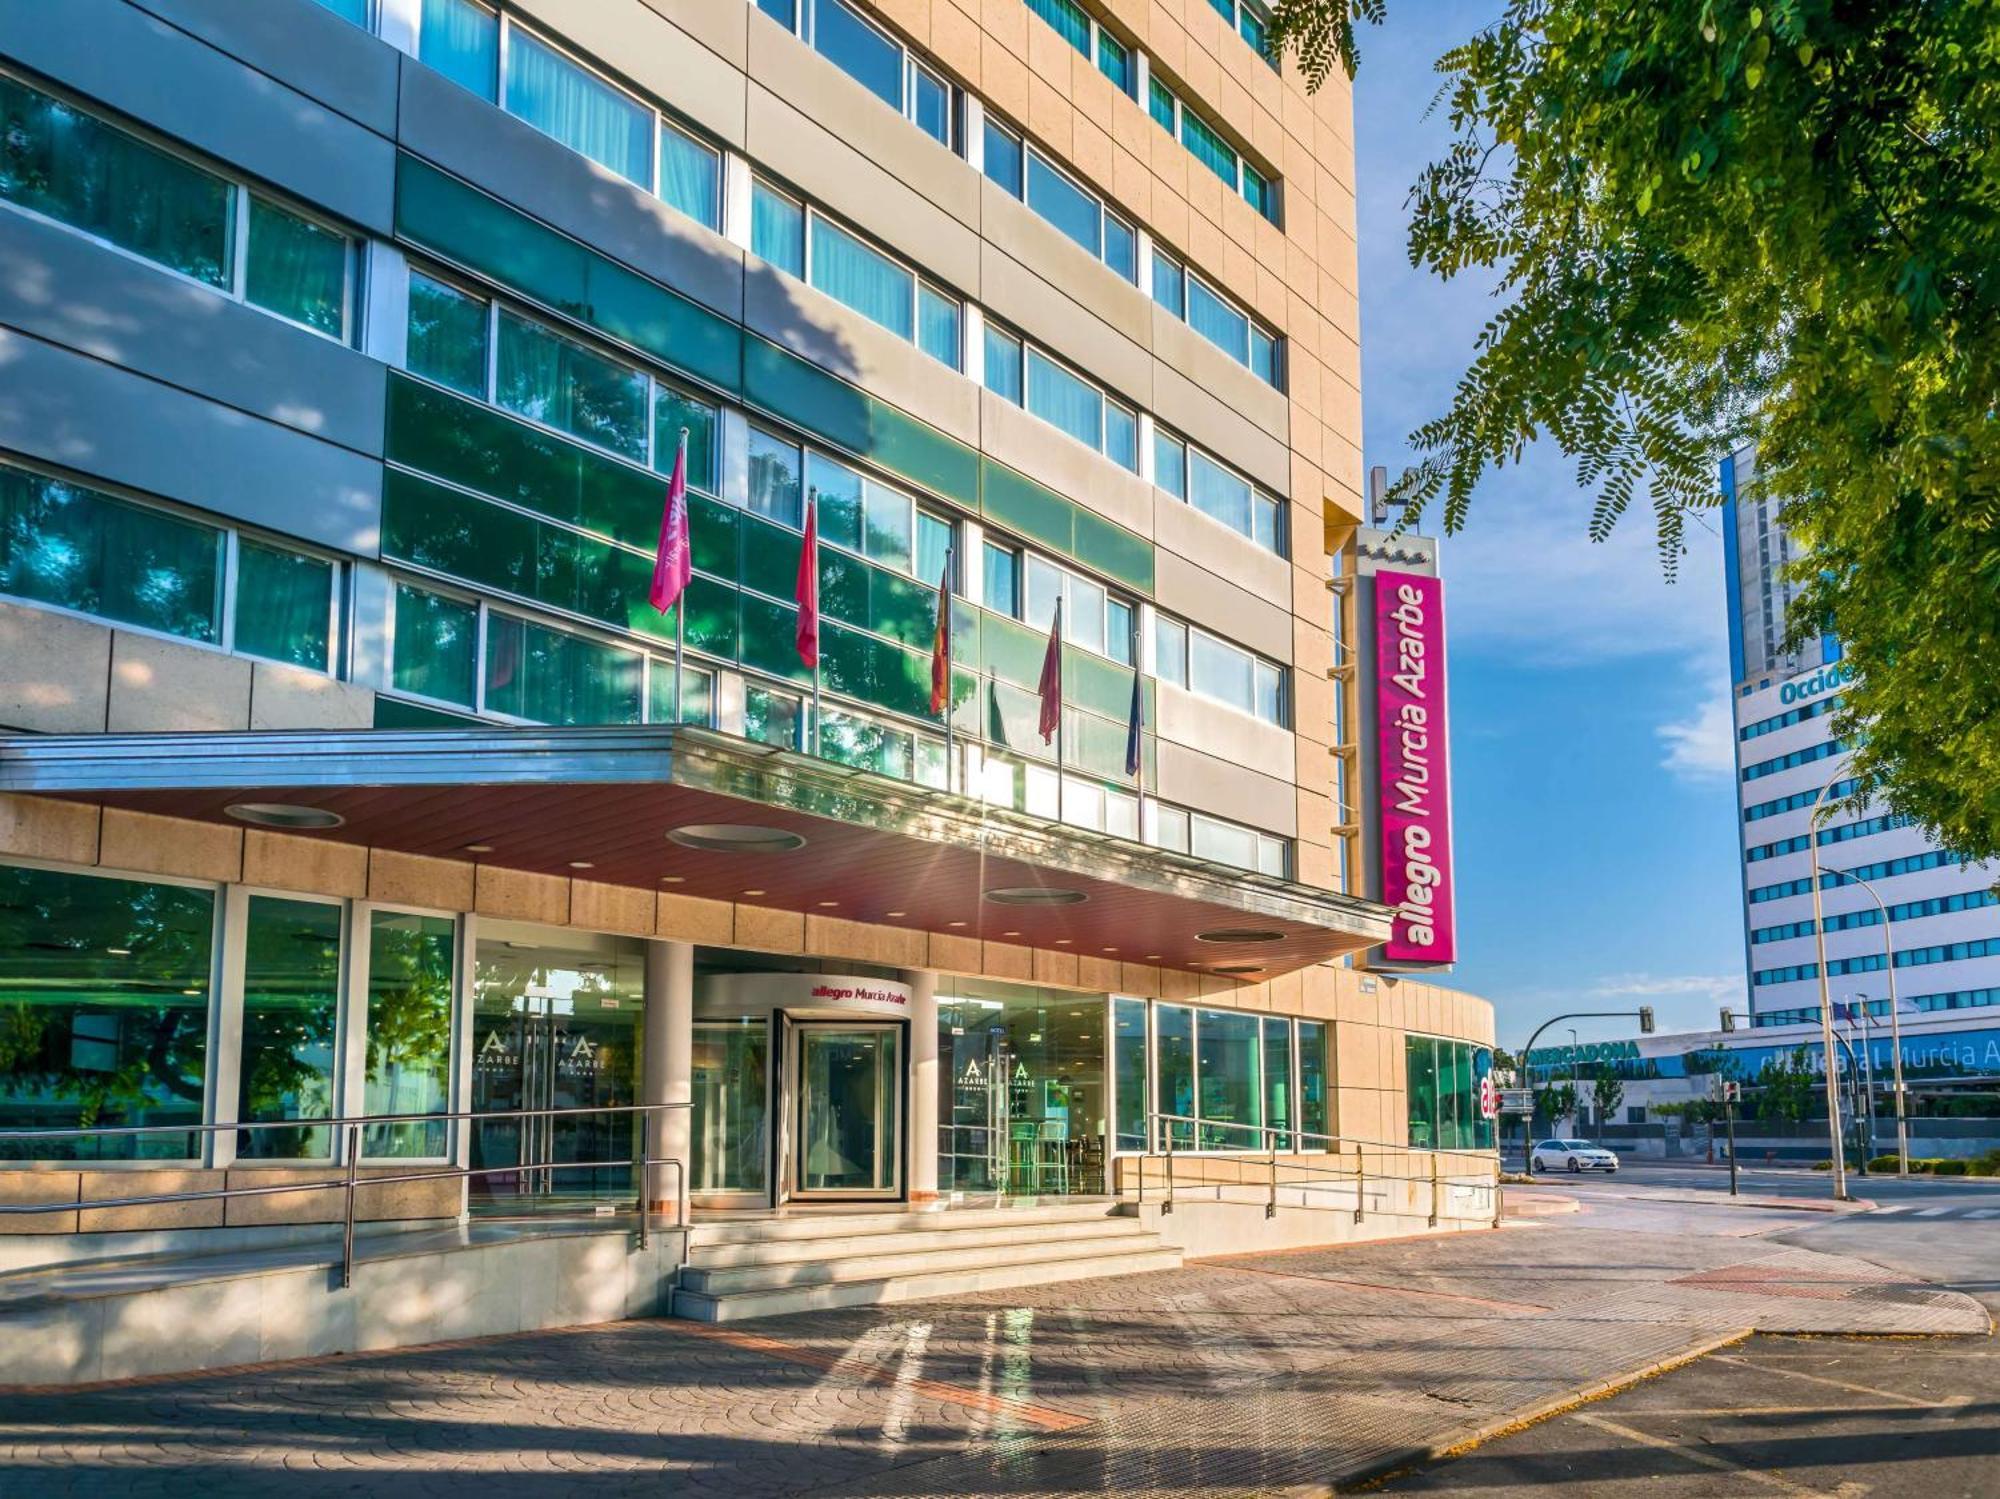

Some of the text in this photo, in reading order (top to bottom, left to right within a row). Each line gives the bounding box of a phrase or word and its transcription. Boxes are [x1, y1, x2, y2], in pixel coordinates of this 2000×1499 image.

[1390, 584, 1441, 946] allegro Murcia Azarbe
[811, 984, 853, 1001] allegro
[855, 987, 885, 1001] Murcia
[472, 1055, 519, 1065] ZARBE
[1891, 1041, 1976, 1069] Murcia
